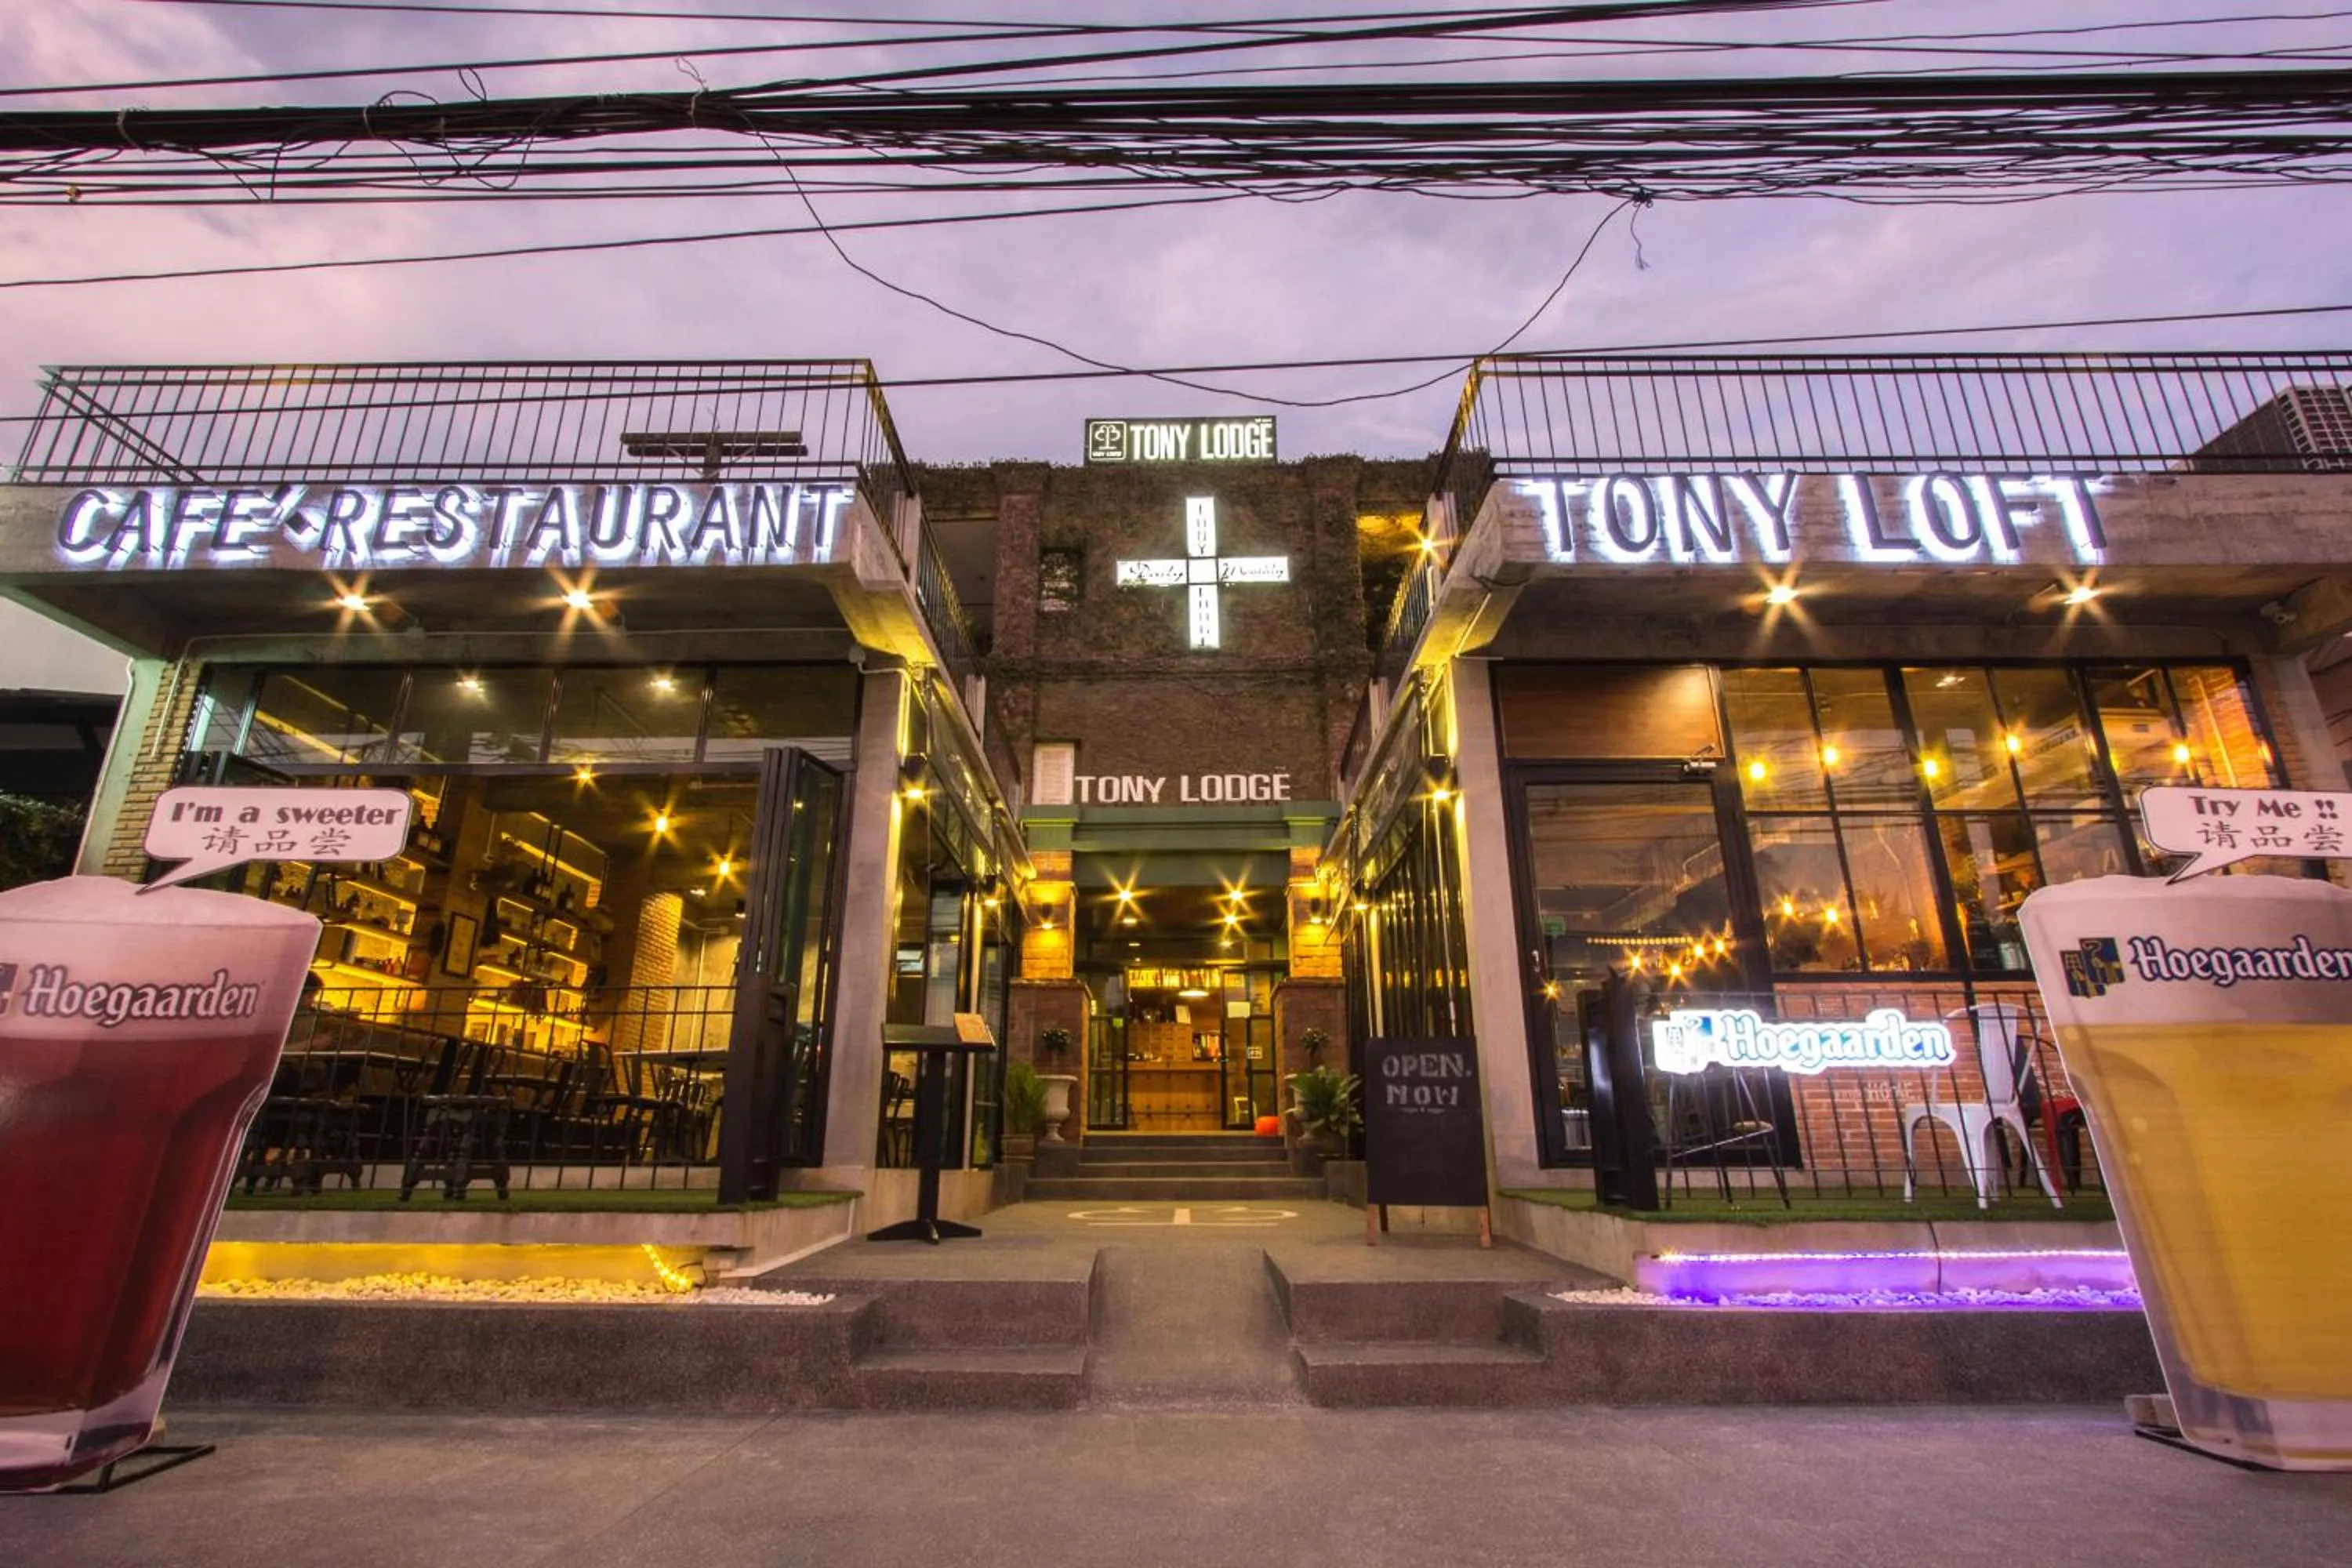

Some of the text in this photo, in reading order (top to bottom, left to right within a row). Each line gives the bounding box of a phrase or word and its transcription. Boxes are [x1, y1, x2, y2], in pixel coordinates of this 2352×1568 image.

[1130, 422, 1273, 459] TONY LODGE
[319, 482, 849, 554] RESTAURANT
[1525, 471, 2111, 554] TONY LOFT
[1075, 772, 1291, 804] TONY LODGE
[171, 802, 403, 826] I'm a sweeter
[2189, 796, 2241, 816] Try
[2257, 798, 2302, 818] Me
[201, 826, 352, 856] 请品尝
[2195, 821, 2345, 852] 请品尝
[2127, 934, 2352, 987] Hoegaarden
[24, 964, 263, 1029] Hoegaarden
[1721, 1013, 1951, 1069] Hoegaarden
[1386, 1084, 1459, 1105] NOW
